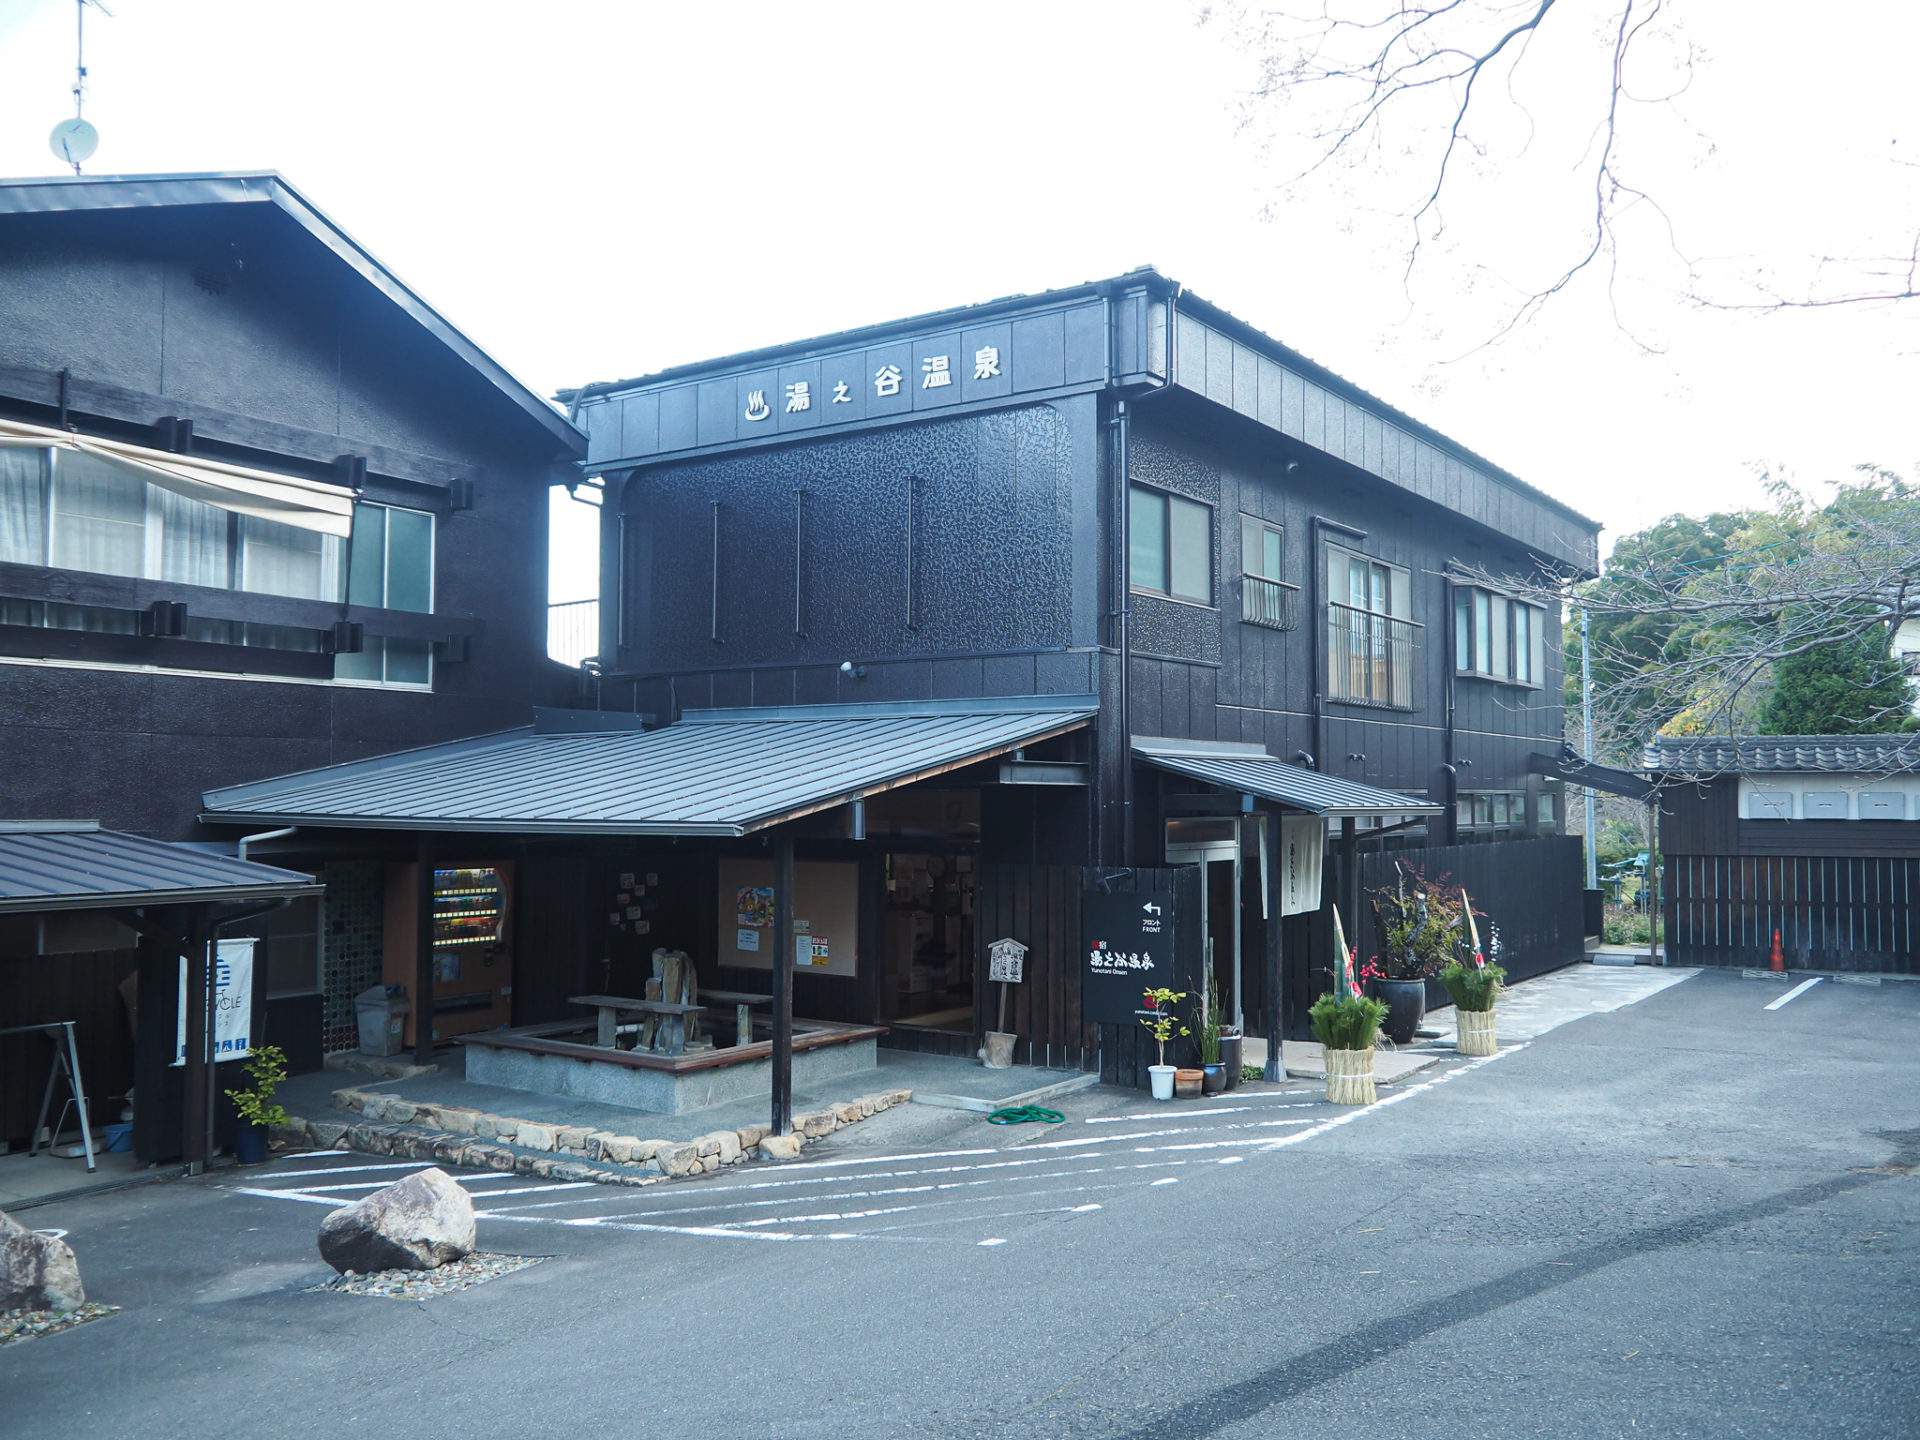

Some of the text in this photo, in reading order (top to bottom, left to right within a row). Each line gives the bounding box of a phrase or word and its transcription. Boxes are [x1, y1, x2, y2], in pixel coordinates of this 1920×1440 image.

[785, 345, 1001, 413] 湯之谷温泉
